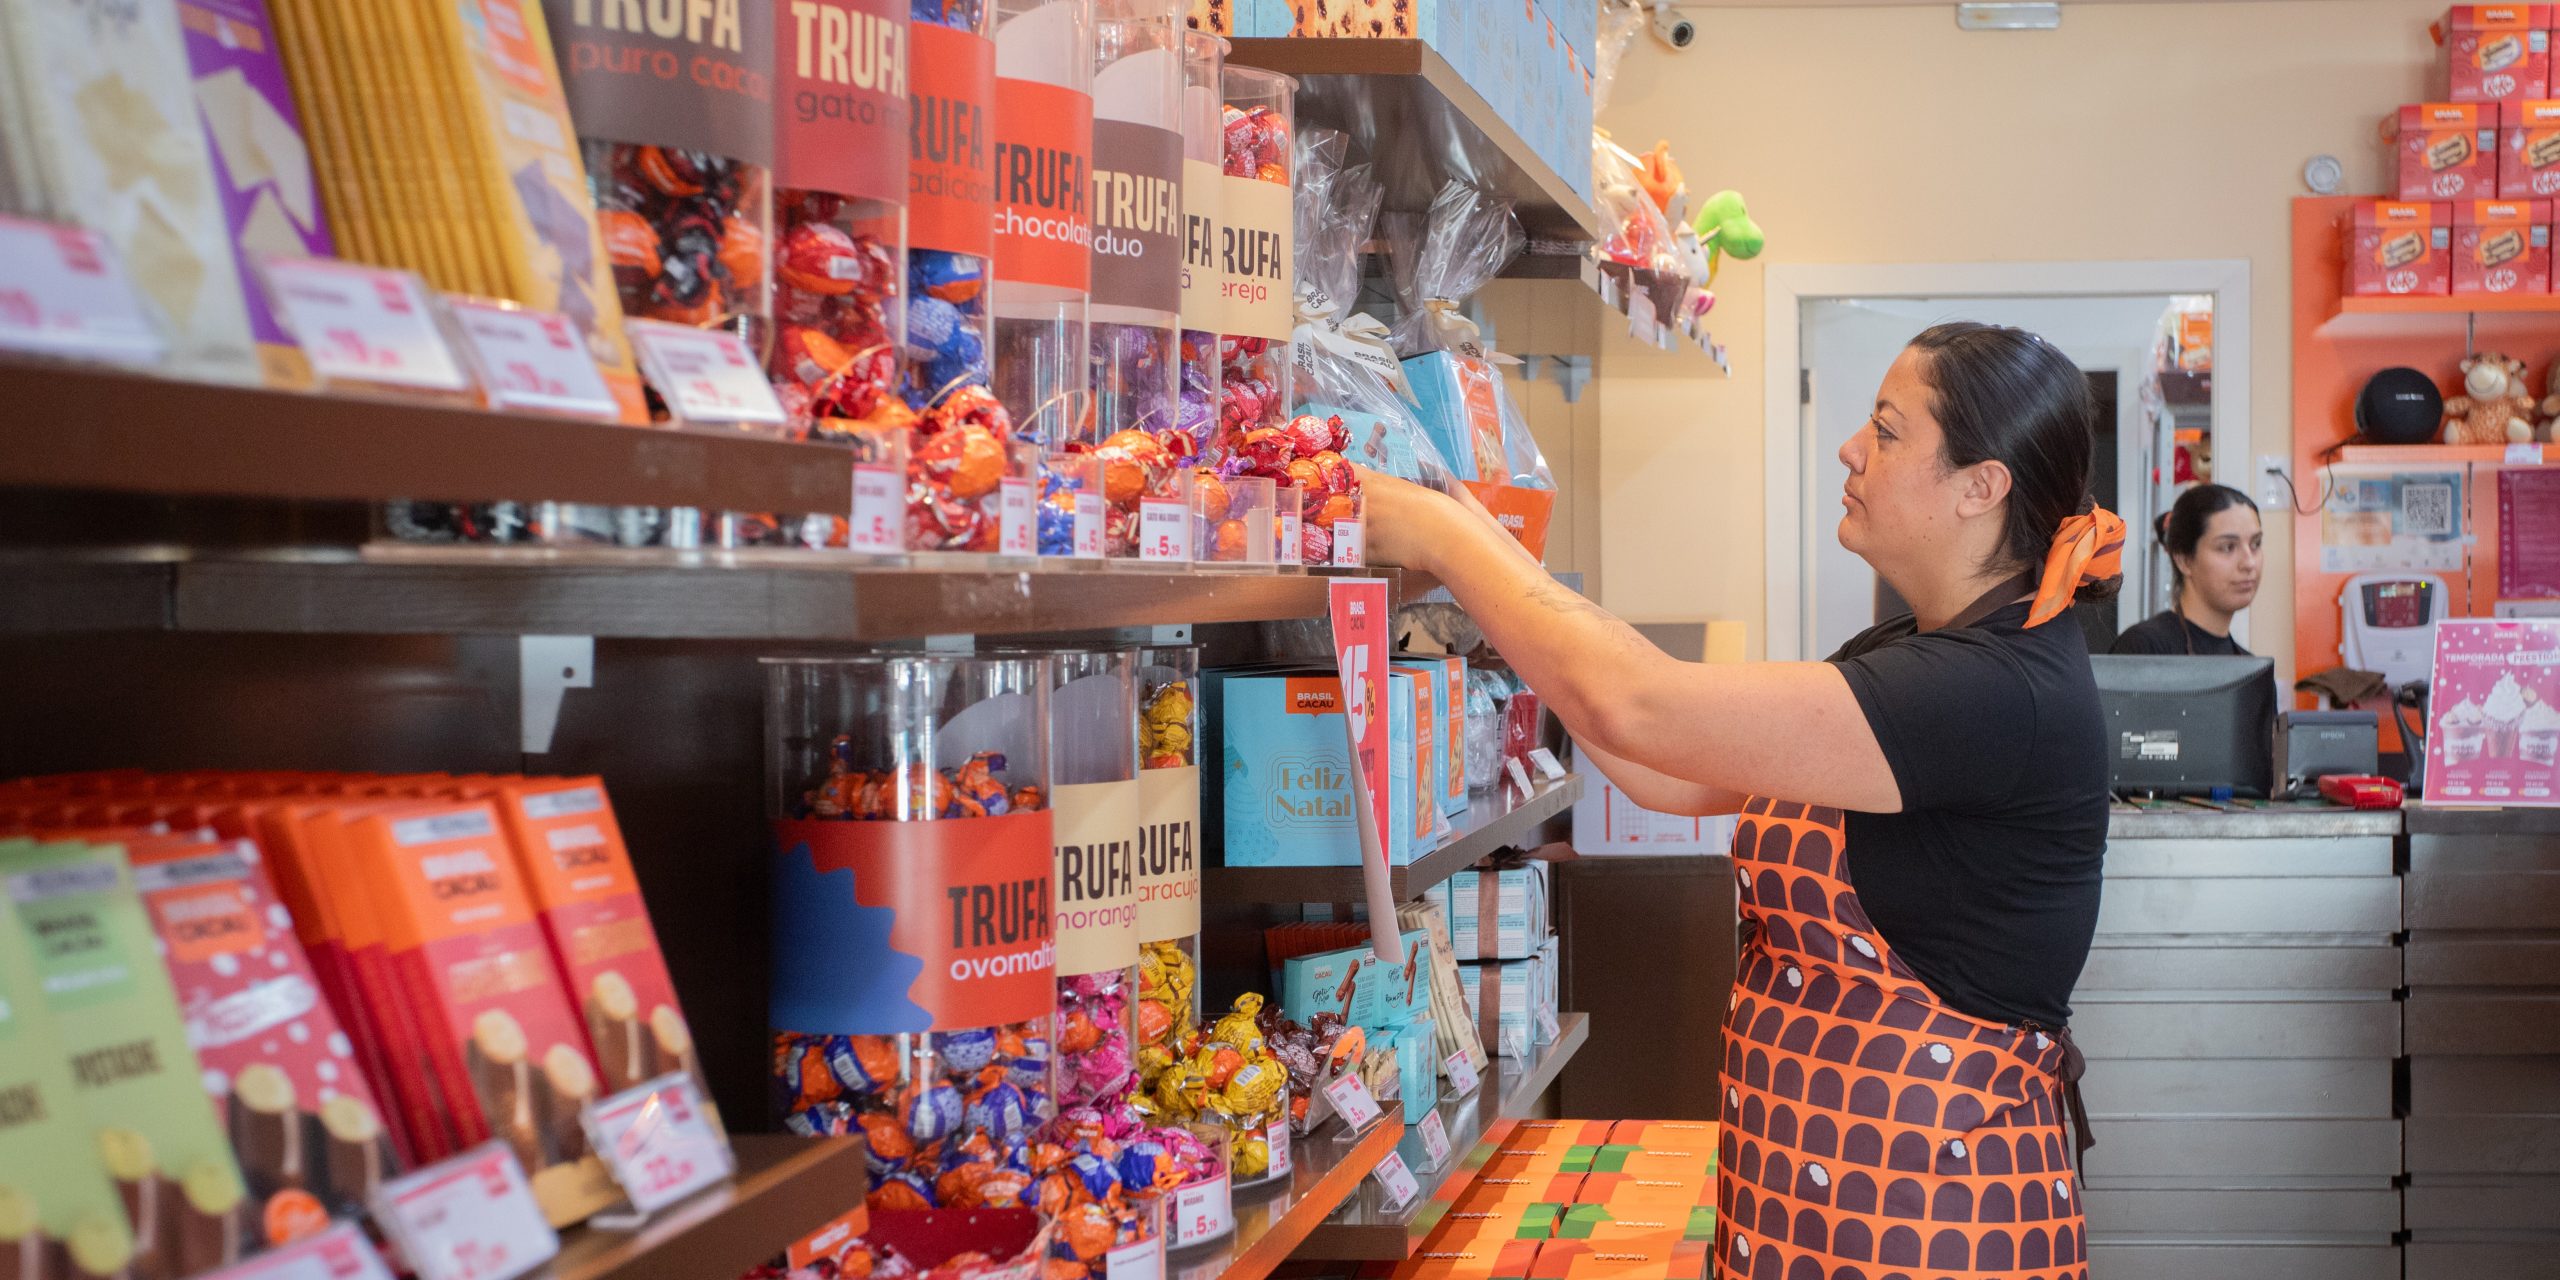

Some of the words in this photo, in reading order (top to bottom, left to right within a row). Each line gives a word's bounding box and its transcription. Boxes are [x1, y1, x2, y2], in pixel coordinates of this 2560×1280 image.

[570, 42, 679, 80] puro
[791, 1, 906, 100] TRUFA
[795, 90, 876, 126] gato
[1092, 169, 1178, 238] TRUFA
[1093, 229, 1143, 258] duo
[1222, 226, 1282, 281] RUFA
[1498, 513, 1525, 529] BRASIL
[1349, 601, 1366, 616] BRASIL
[1296, 692, 1335, 702] BRASIL
[1296, 700, 1336, 710] CACAU
[1282, 766, 1346, 792] Feliz
[1276, 794, 1351, 818] Natal
[1054, 839, 1133, 903] RUFA
[946, 877, 1050, 949] TRUFA
[1196, 1214, 1218, 1236] 5,19
